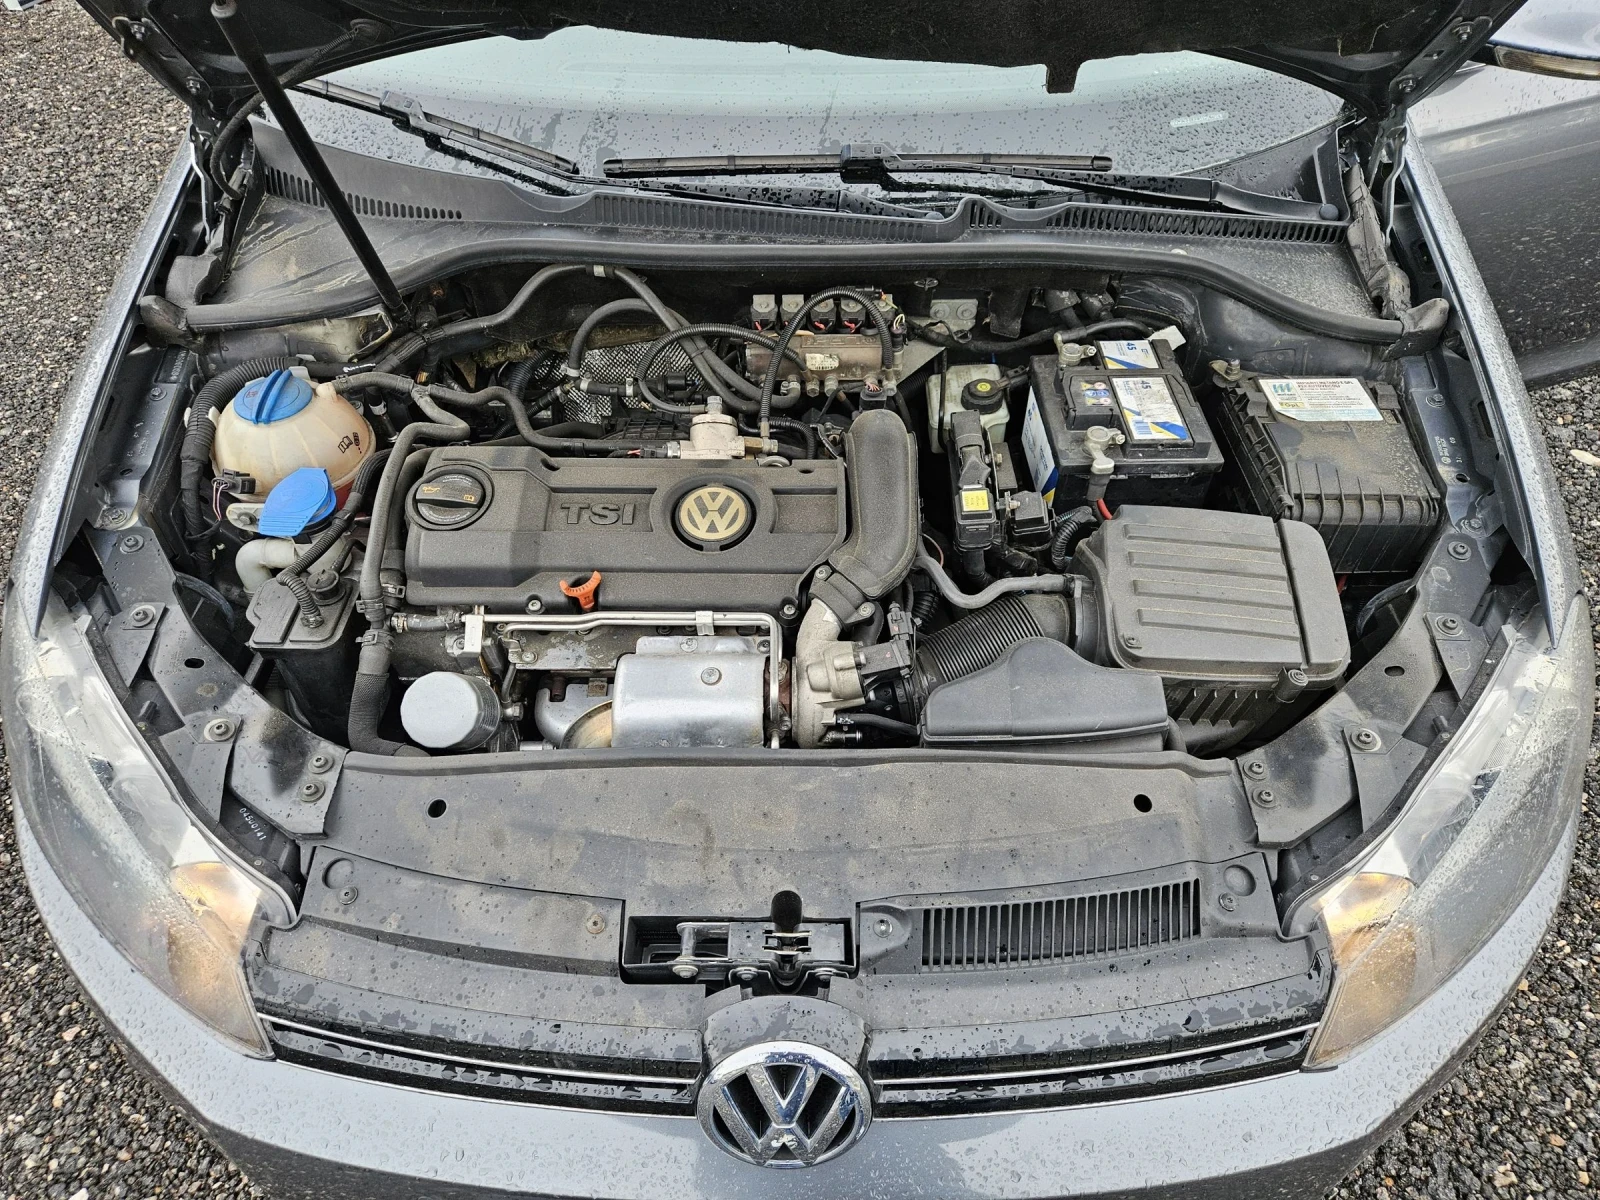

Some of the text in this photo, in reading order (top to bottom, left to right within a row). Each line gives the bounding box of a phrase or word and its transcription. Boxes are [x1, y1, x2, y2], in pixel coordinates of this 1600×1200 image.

[560, 503, 636, 525] TSI
[682, 488, 744, 538] VW
[704, 1052, 866, 1168] VW
